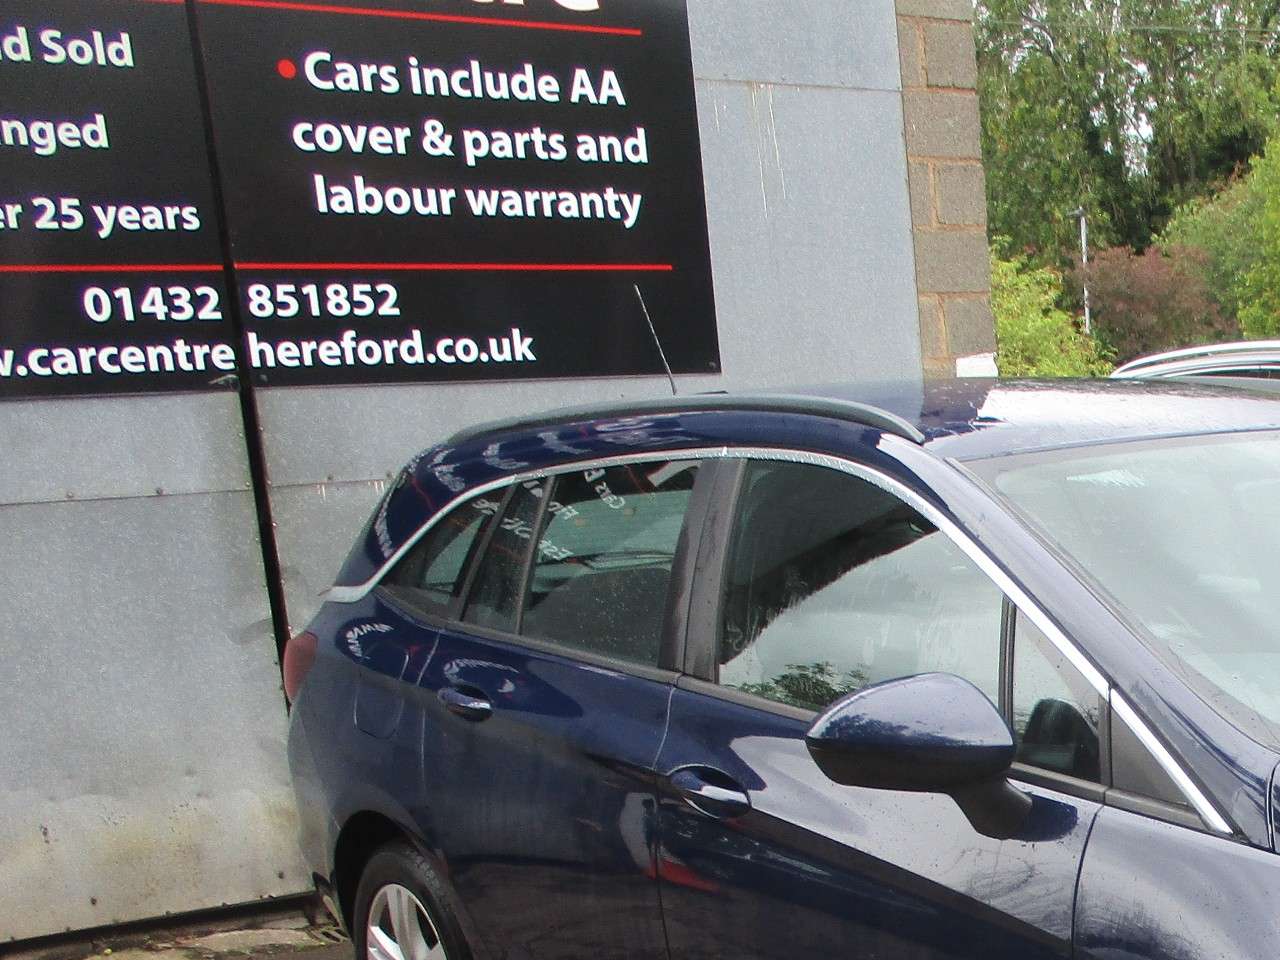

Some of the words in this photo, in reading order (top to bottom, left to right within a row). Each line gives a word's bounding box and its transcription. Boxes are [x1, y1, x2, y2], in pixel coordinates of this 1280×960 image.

[0, 25, 32, 62] d
[39, 28, 134, 67] Sold
[303, 50, 400, 94] Cars
[408, 55, 560, 103] include
[569, 67, 626, 106] AA
[0, 113, 109, 156] nged
[292, 121, 412, 155] cover
[421, 118, 455, 157] &
[462, 126, 568, 167] parts
[576, 126, 649, 164] and
[0, 203, 23, 229] r
[31, 196, 84, 230] 25
[91, 205, 201, 239] years
[313, 173, 457, 215] labour
[464, 186, 642, 229] warranty
[83, 285, 223, 322] 01432
[247, 283, 401, 318] 851852
[247, 327, 537, 368] hereford.co.uk
